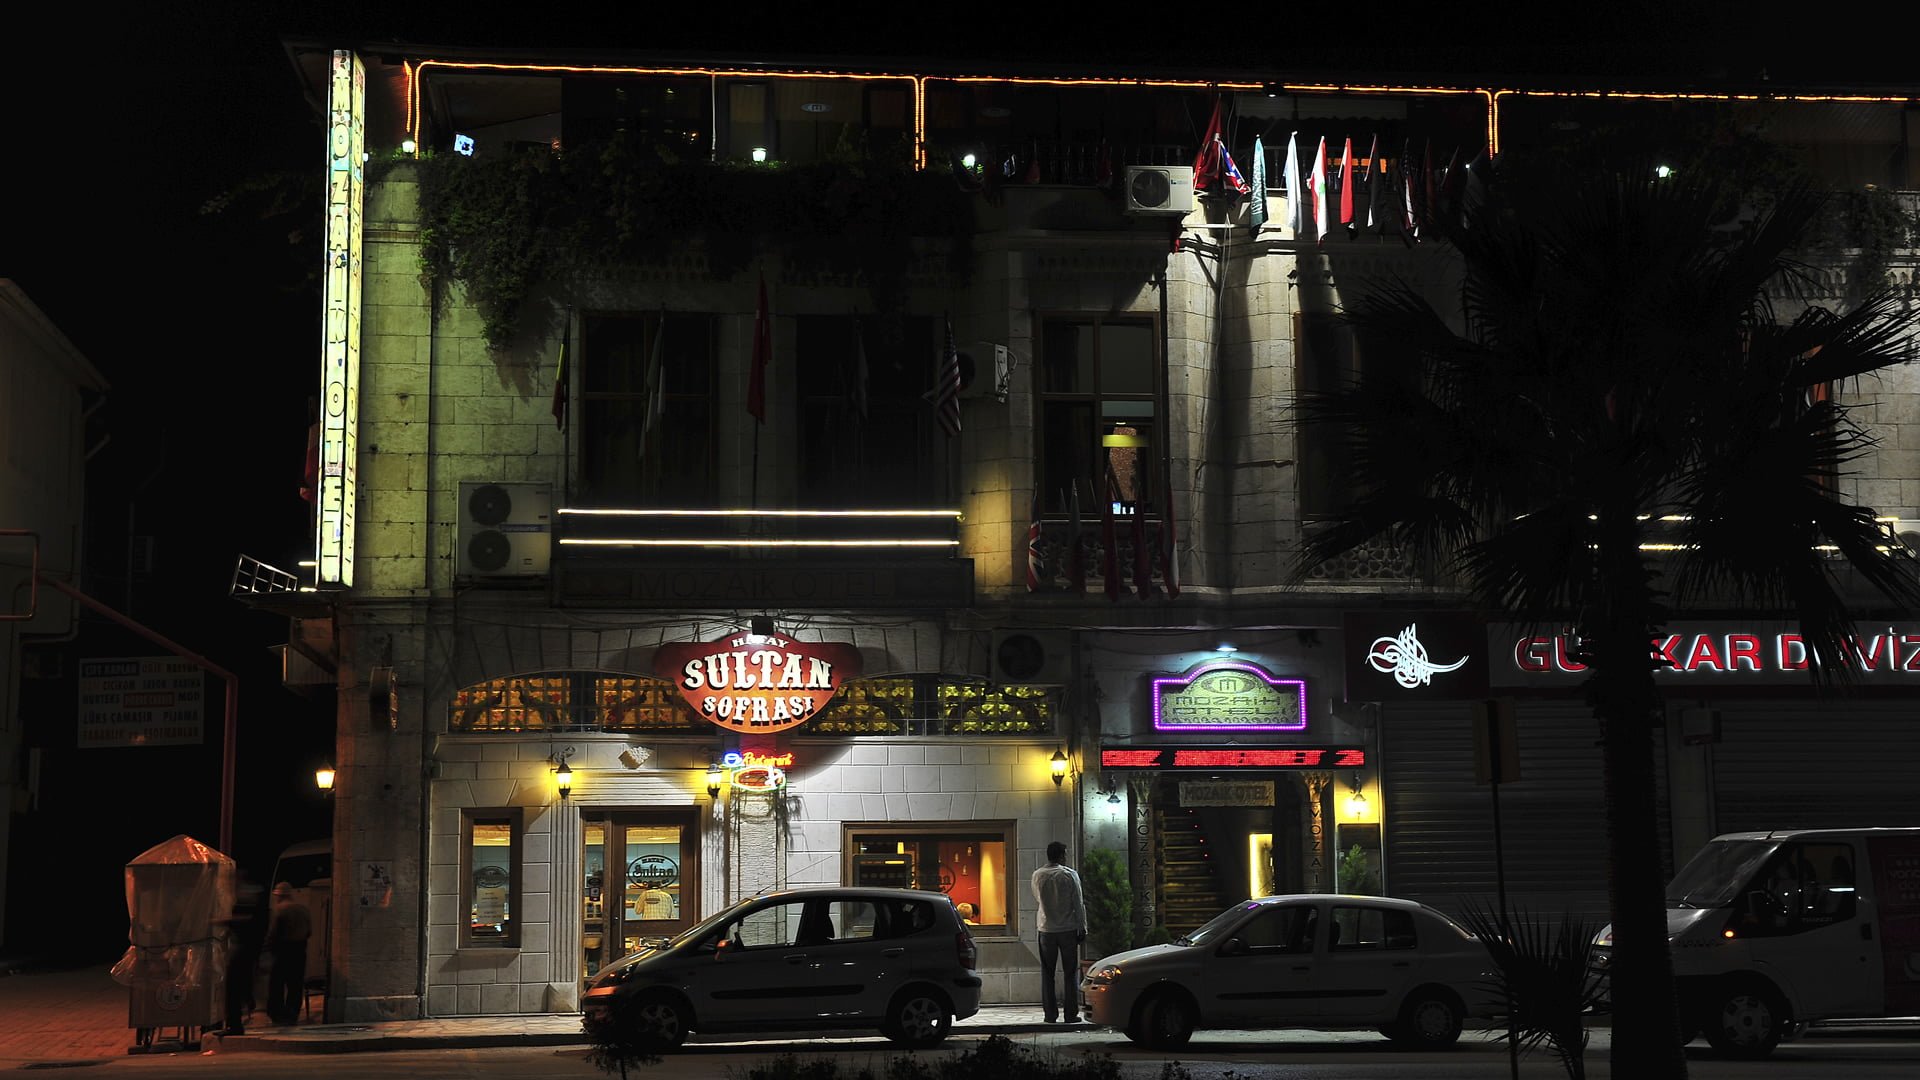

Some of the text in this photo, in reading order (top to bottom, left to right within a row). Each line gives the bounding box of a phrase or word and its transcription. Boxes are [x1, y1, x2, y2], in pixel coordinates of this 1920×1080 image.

[323, 381, 345, 558] OTEL
[791, 571, 890, 598] OTEL
[1776, 625, 1920, 672] DVİZ
[684, 650, 833, 690] SULTAN
[704, 695, 814, 724] SOFRASI
[1173, 707, 1280, 715] OTEL
[1310, 808, 1322, 894] MOZAI
